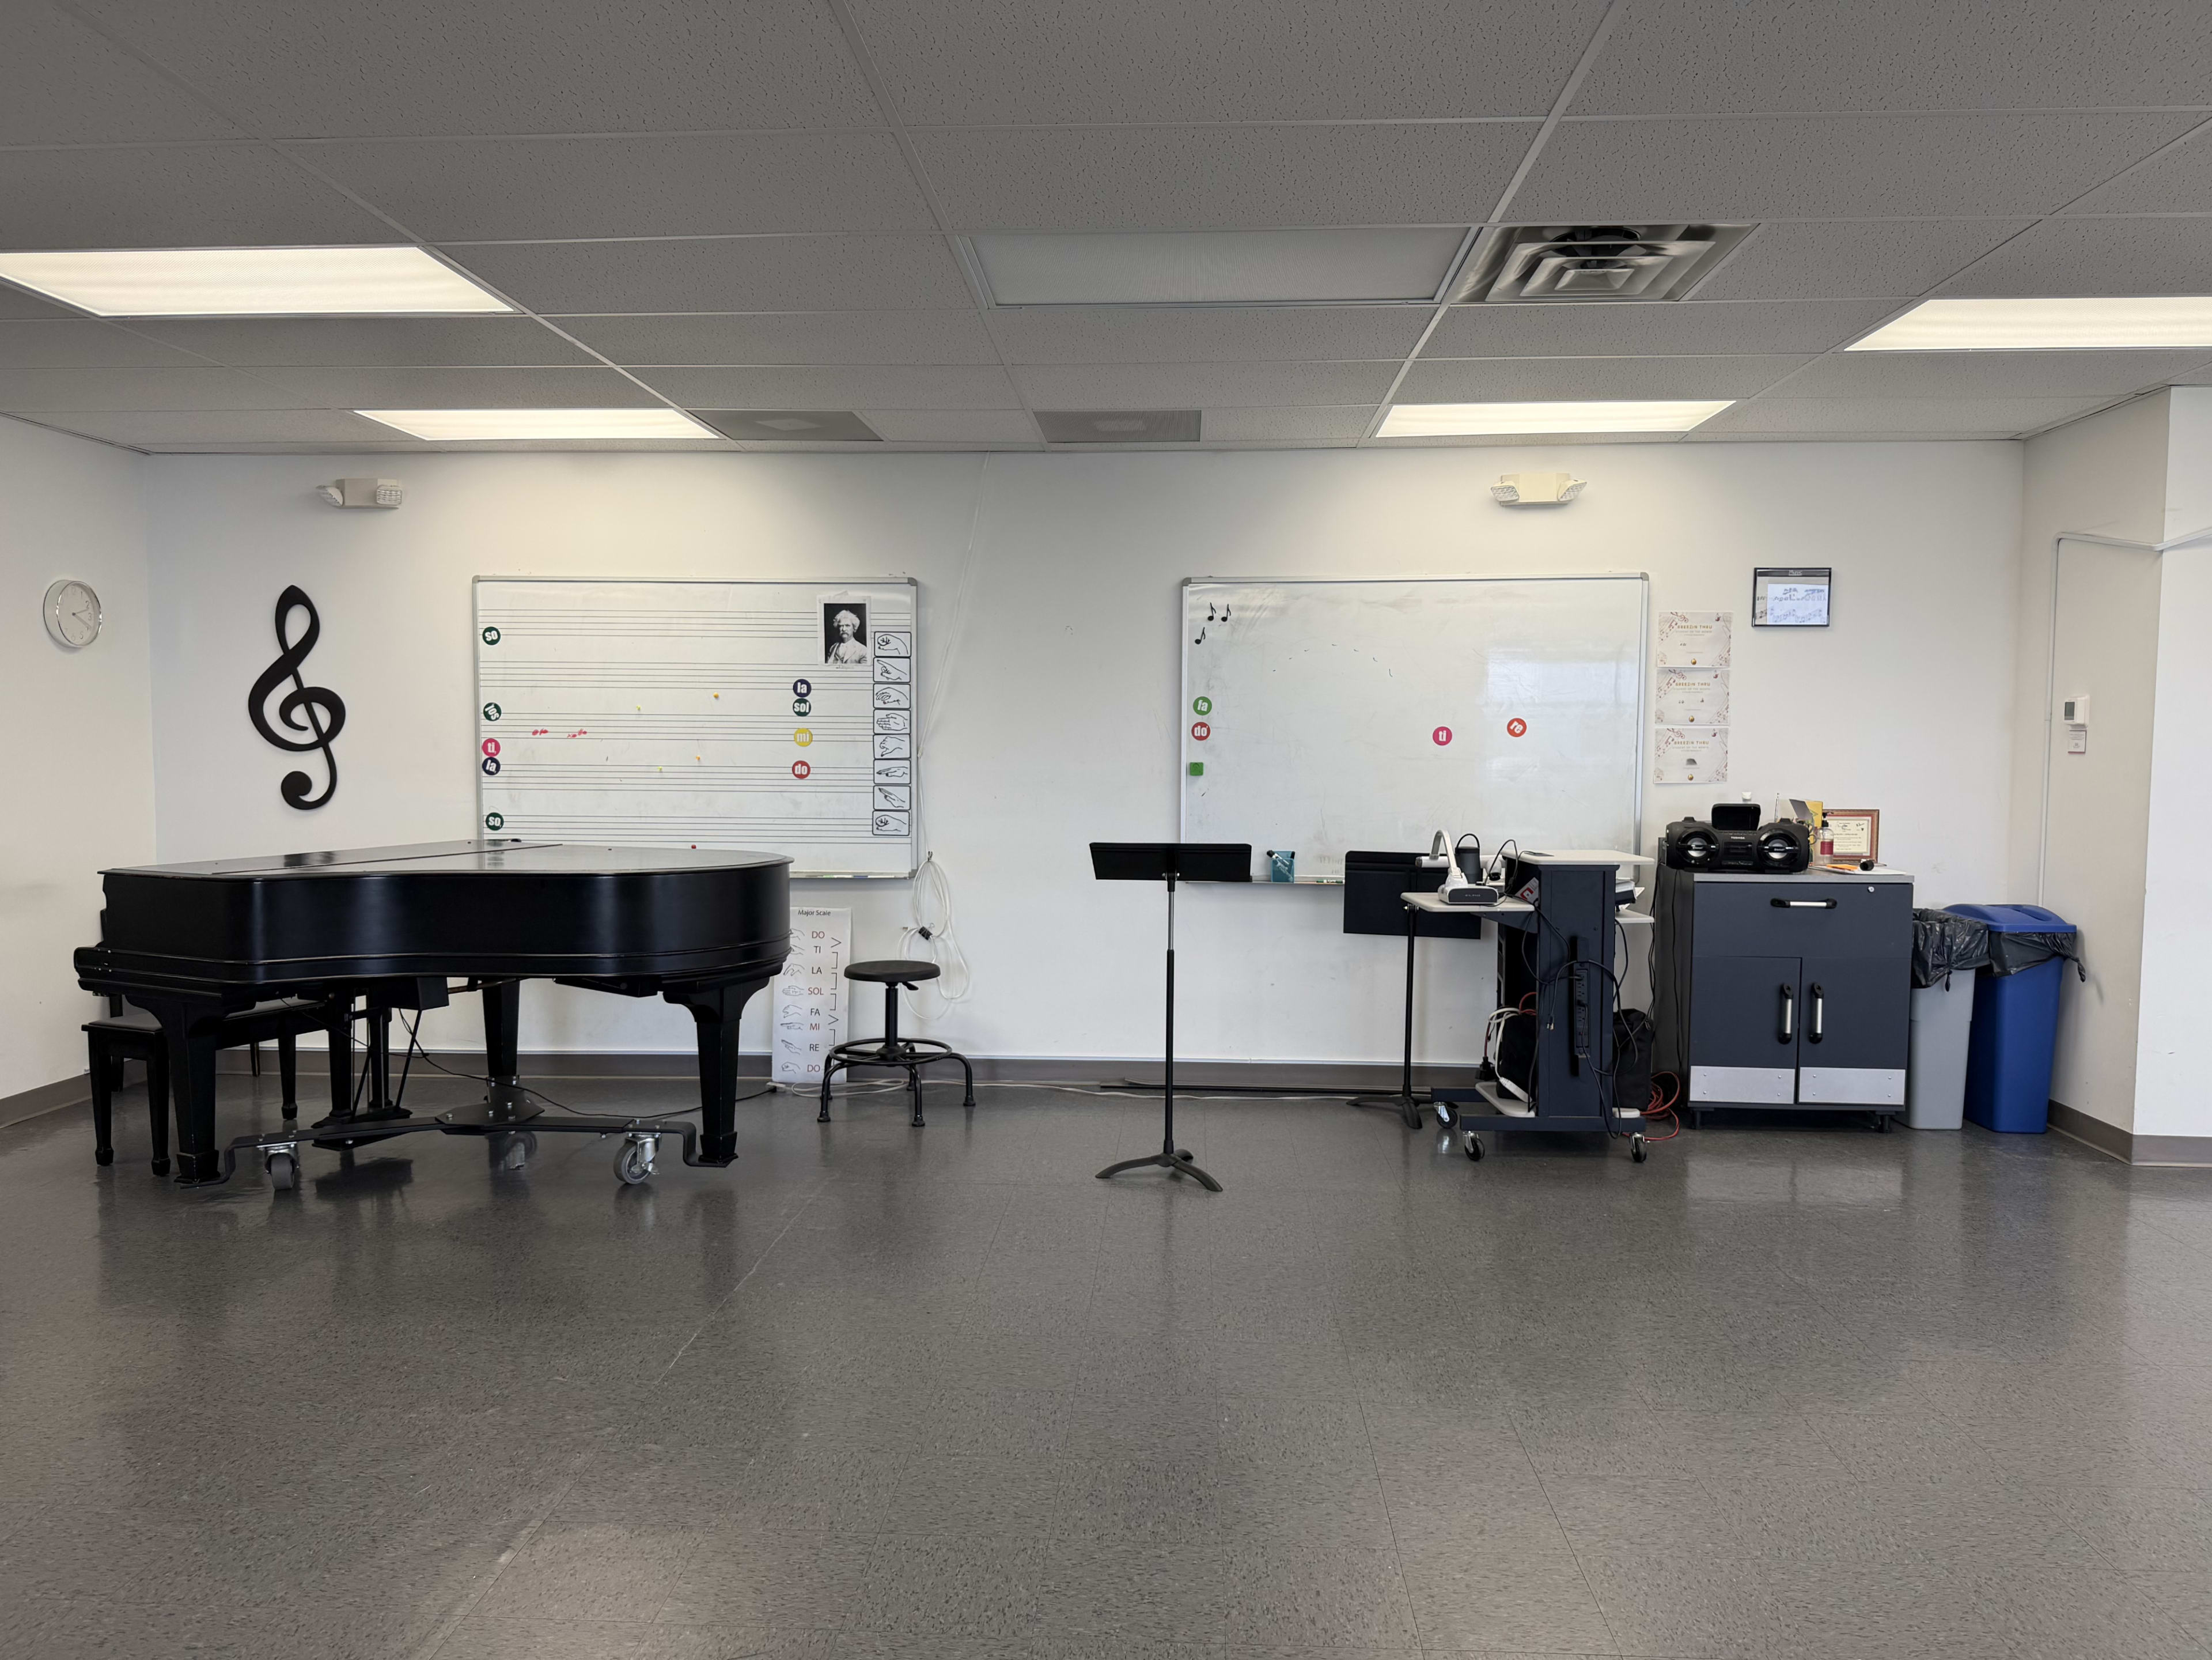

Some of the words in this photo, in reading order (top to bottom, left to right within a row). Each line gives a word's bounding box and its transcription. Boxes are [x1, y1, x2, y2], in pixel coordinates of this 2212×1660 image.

[85, 600, 89, 608] 2
[797, 682, 807, 693] la
[794, 702, 809, 713] sol
[1197, 699, 1209, 712] fa
[1510, 720, 1524, 733] re
[797, 732, 810, 742] mi
[1438, 730, 1446, 742] ti
[794, 763, 808, 774] do
[812, 931, 825, 939] DO
[813, 946, 821, 954] TI
[812, 967, 822, 975] LA
[808, 987, 824, 995] SOL
[809, 1043, 819, 1052] RE
[807, 1064, 820, 1072] DO
